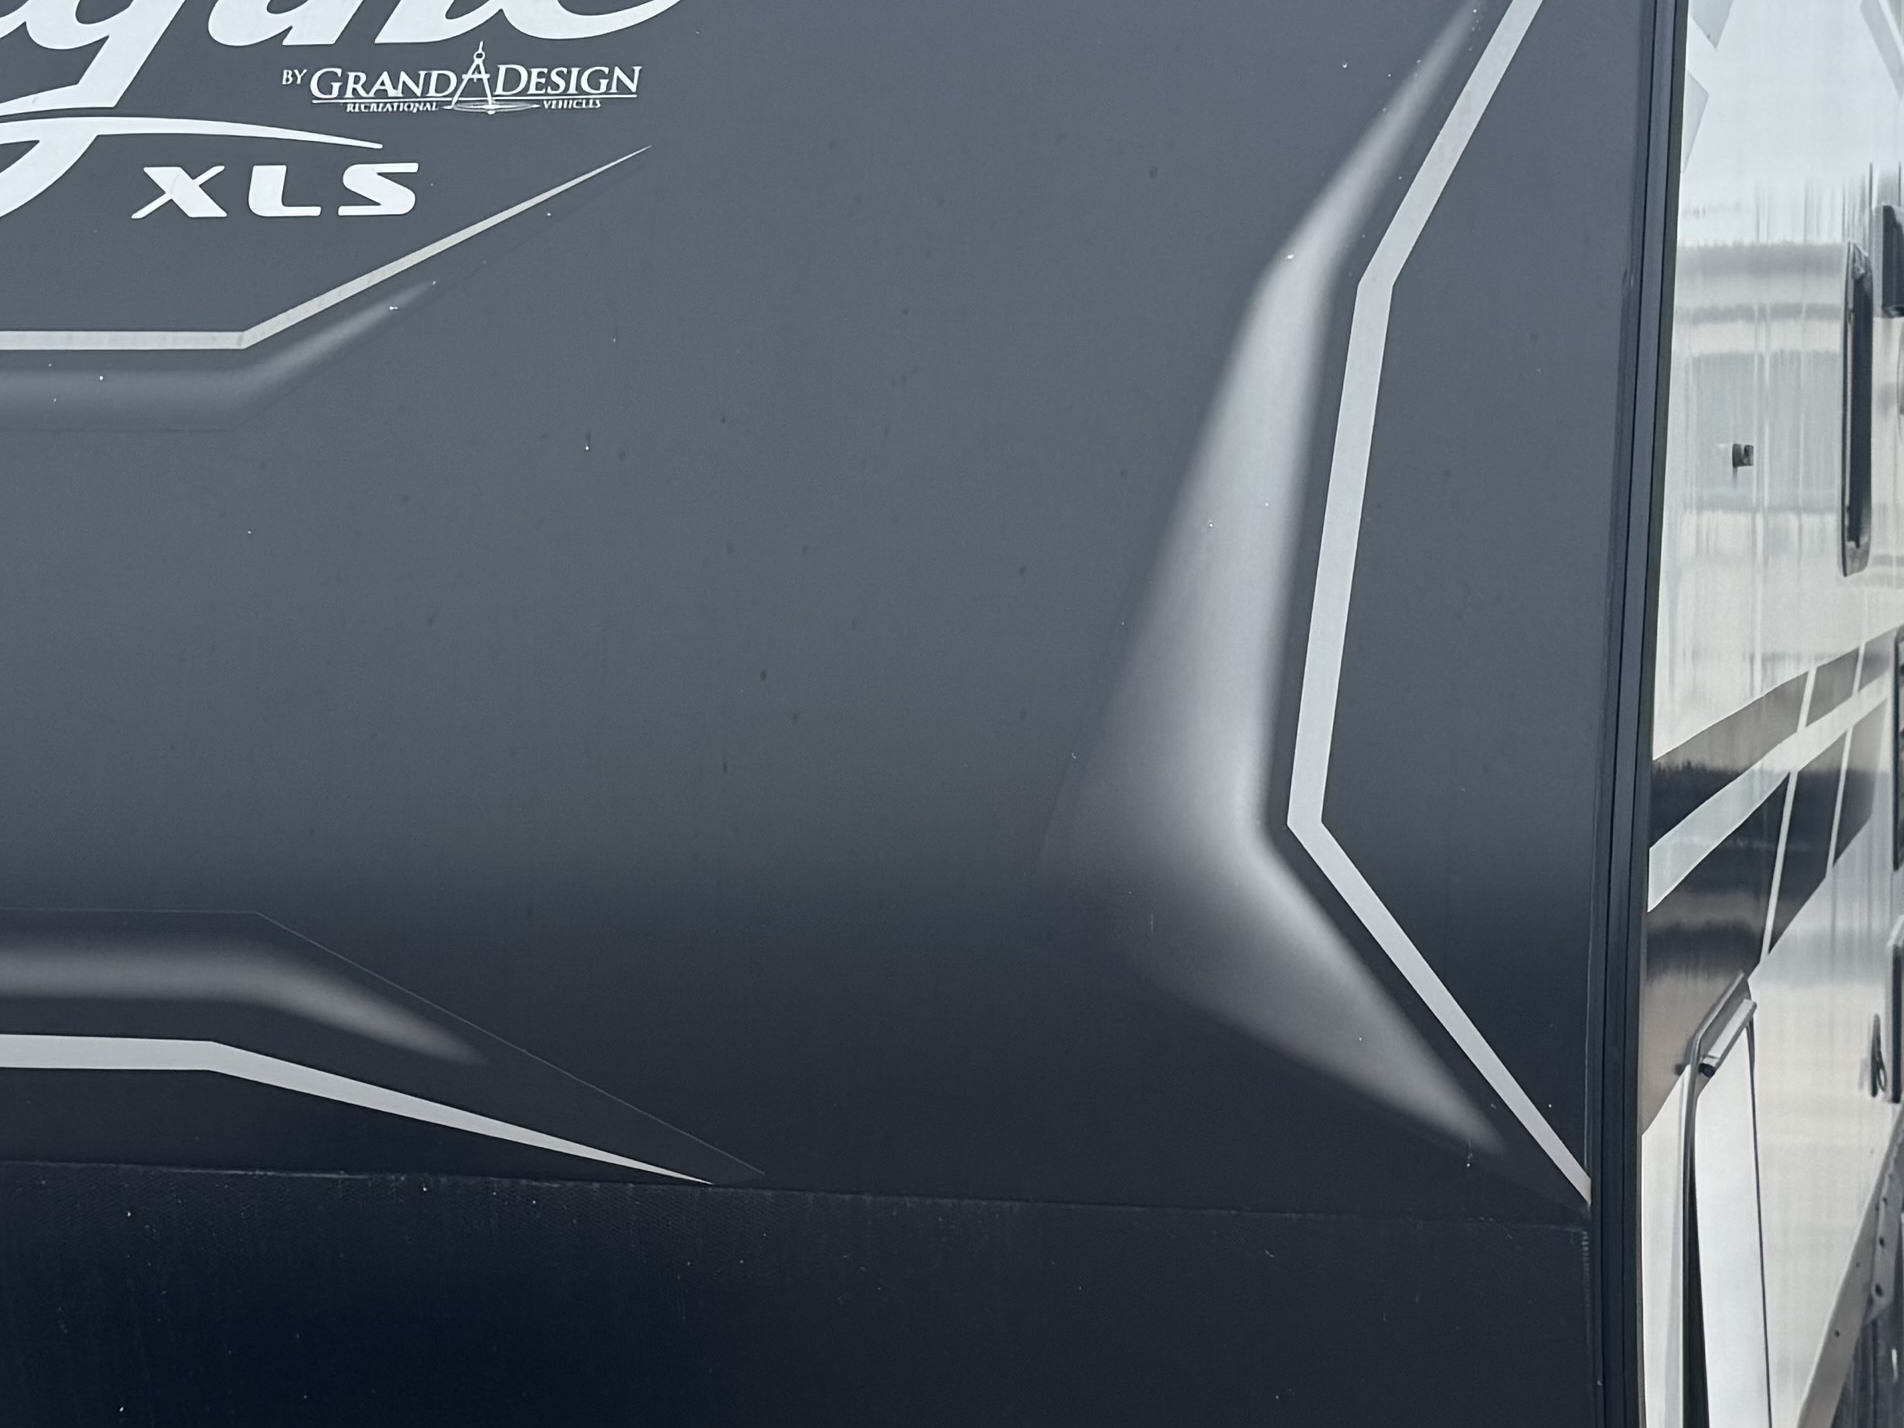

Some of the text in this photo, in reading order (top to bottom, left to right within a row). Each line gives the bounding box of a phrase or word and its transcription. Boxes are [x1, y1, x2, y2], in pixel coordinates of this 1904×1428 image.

[281, 63, 643, 100] BY GRAND DESIGN
[345, 101, 440, 114] RECREATIONAL
[131, 161, 419, 220] XLS
